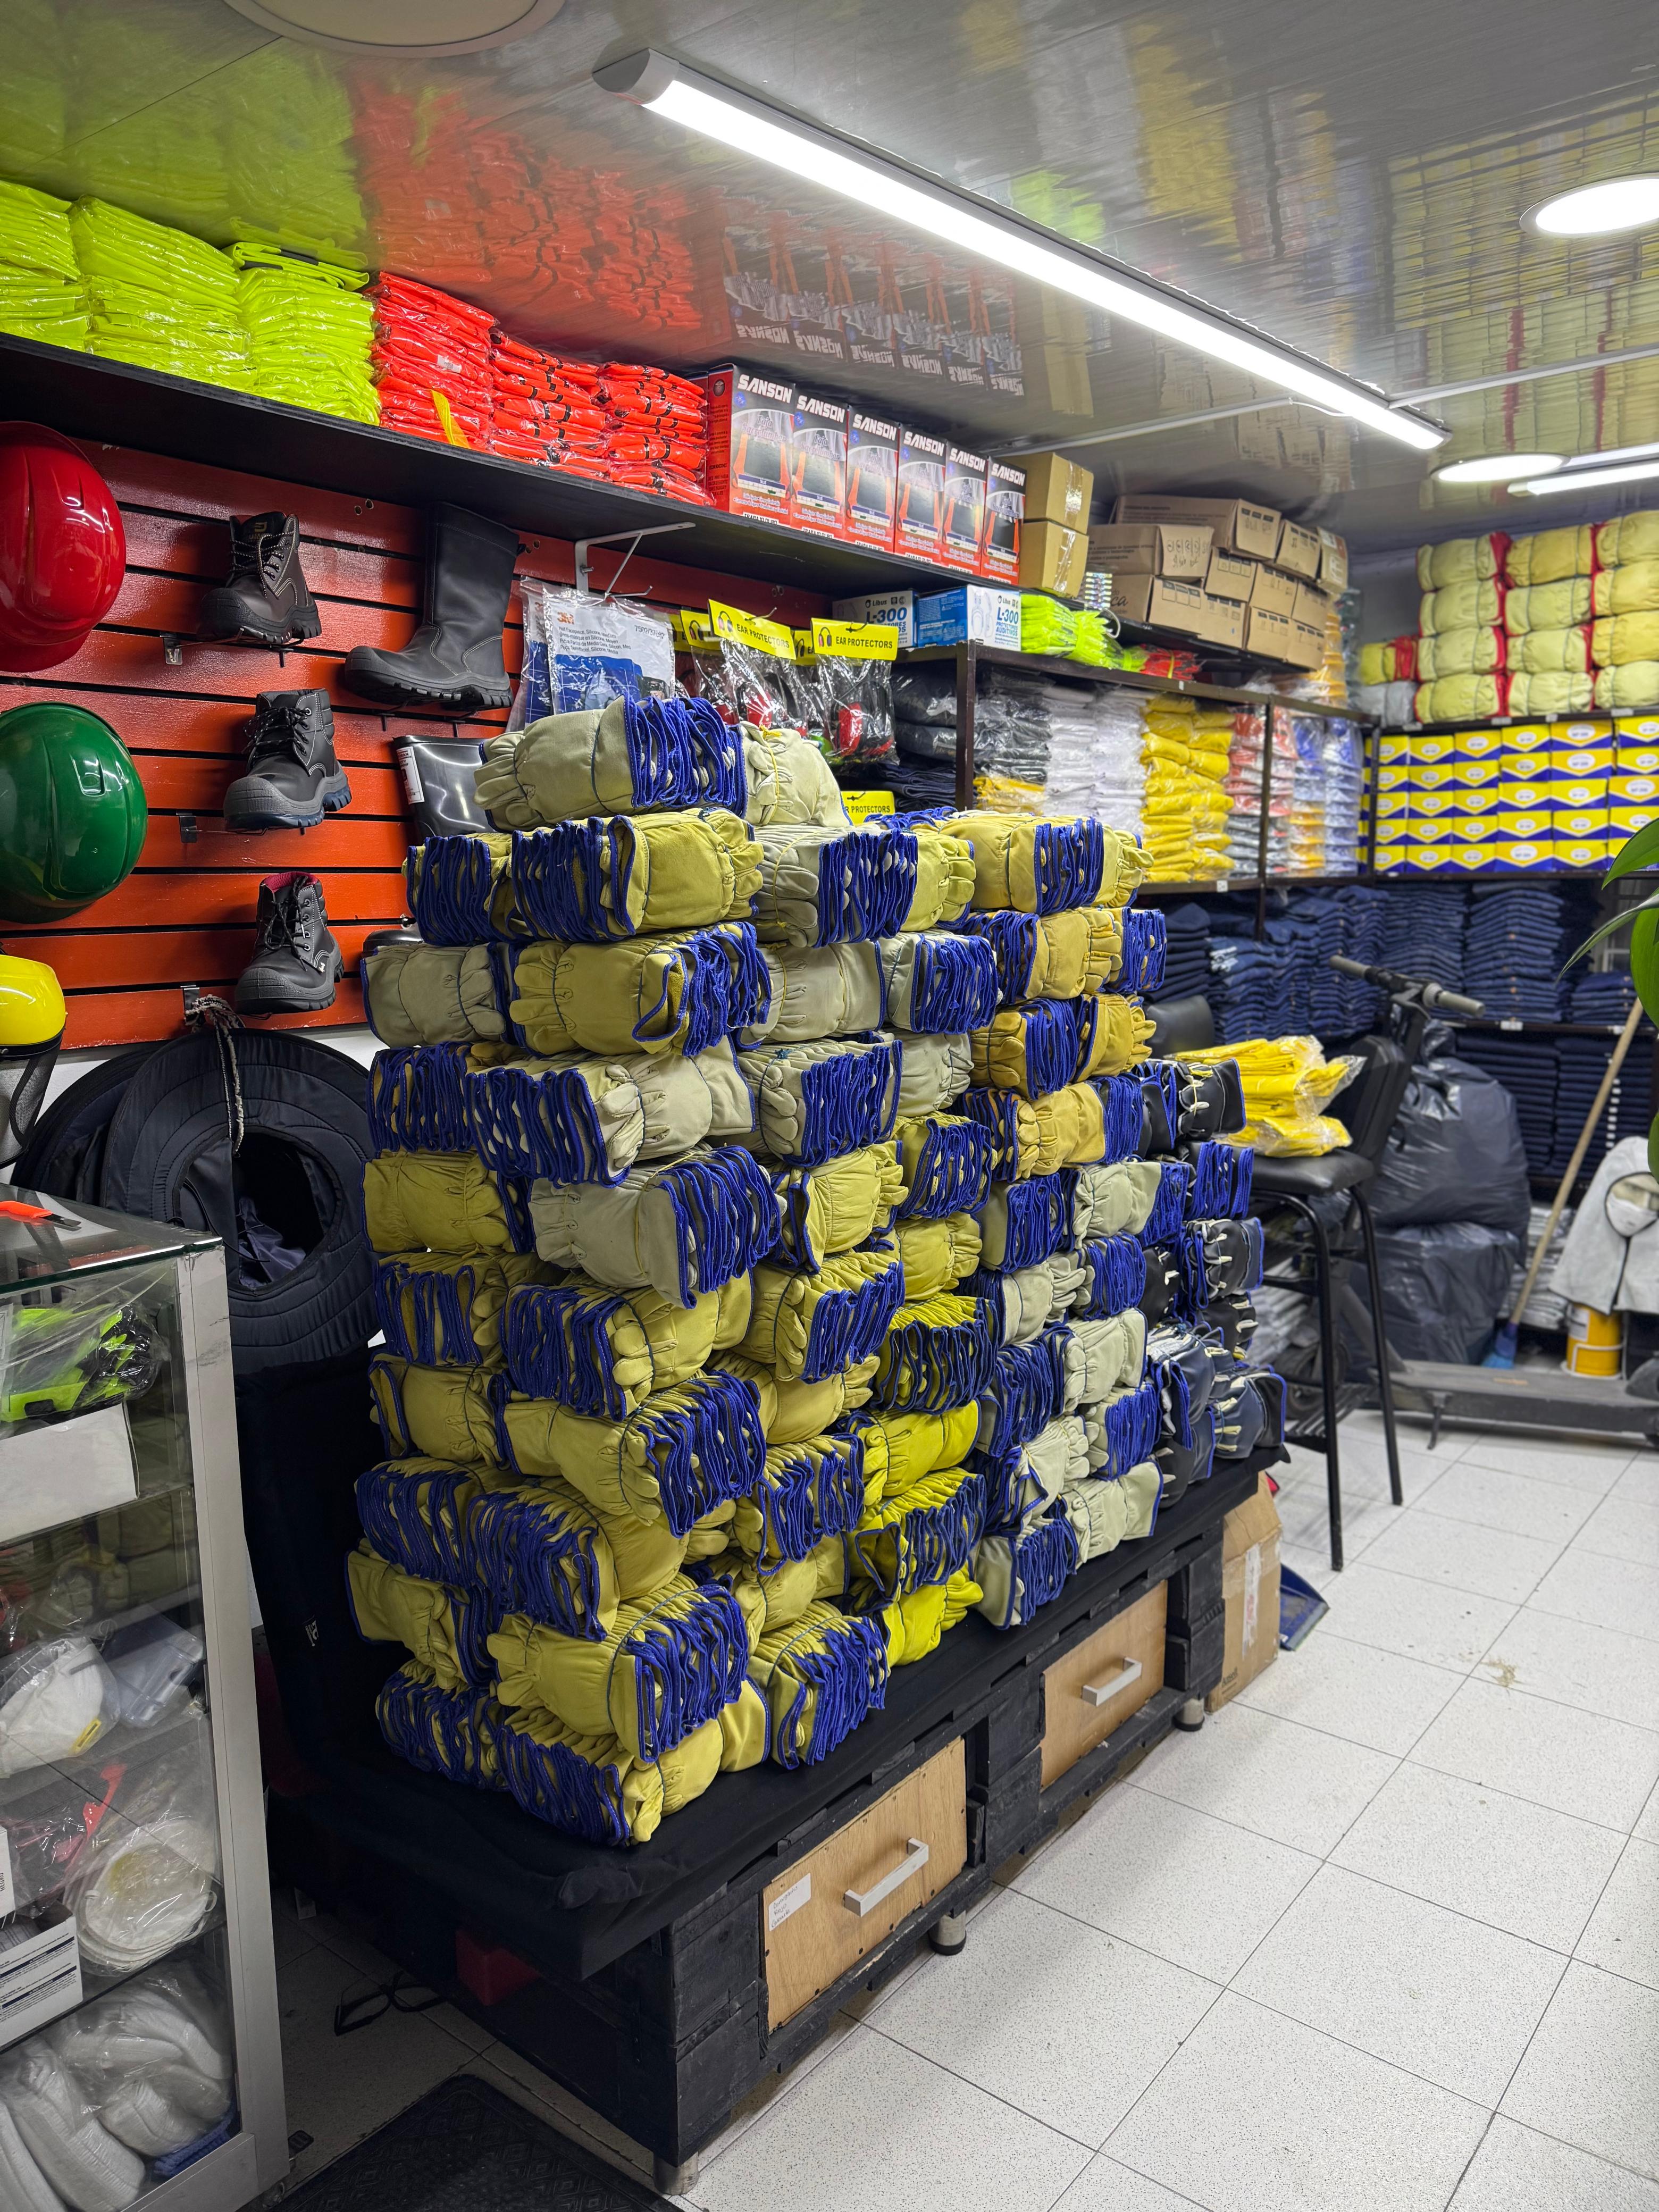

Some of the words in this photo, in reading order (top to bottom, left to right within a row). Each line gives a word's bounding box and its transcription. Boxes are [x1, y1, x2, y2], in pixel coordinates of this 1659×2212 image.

[738, 374, 792, 403] SANSON
[797, 395, 845, 423] SANSON
[852, 414, 896, 441] SANSON
[903, 431, 945, 456] SANSON
[950, 448, 986, 472] SANSON
[991, 463, 1025, 487] SANSON
[867, 607, 907, 624] L-300
[997, 607, 1019, 624] L-300
[737, 624, 749, 635] EAR
[749, 630, 790, 648] PROTECTORS
[836, 636, 847, 645] EAR
[848, 637, 893, 649] PROTECTORS
